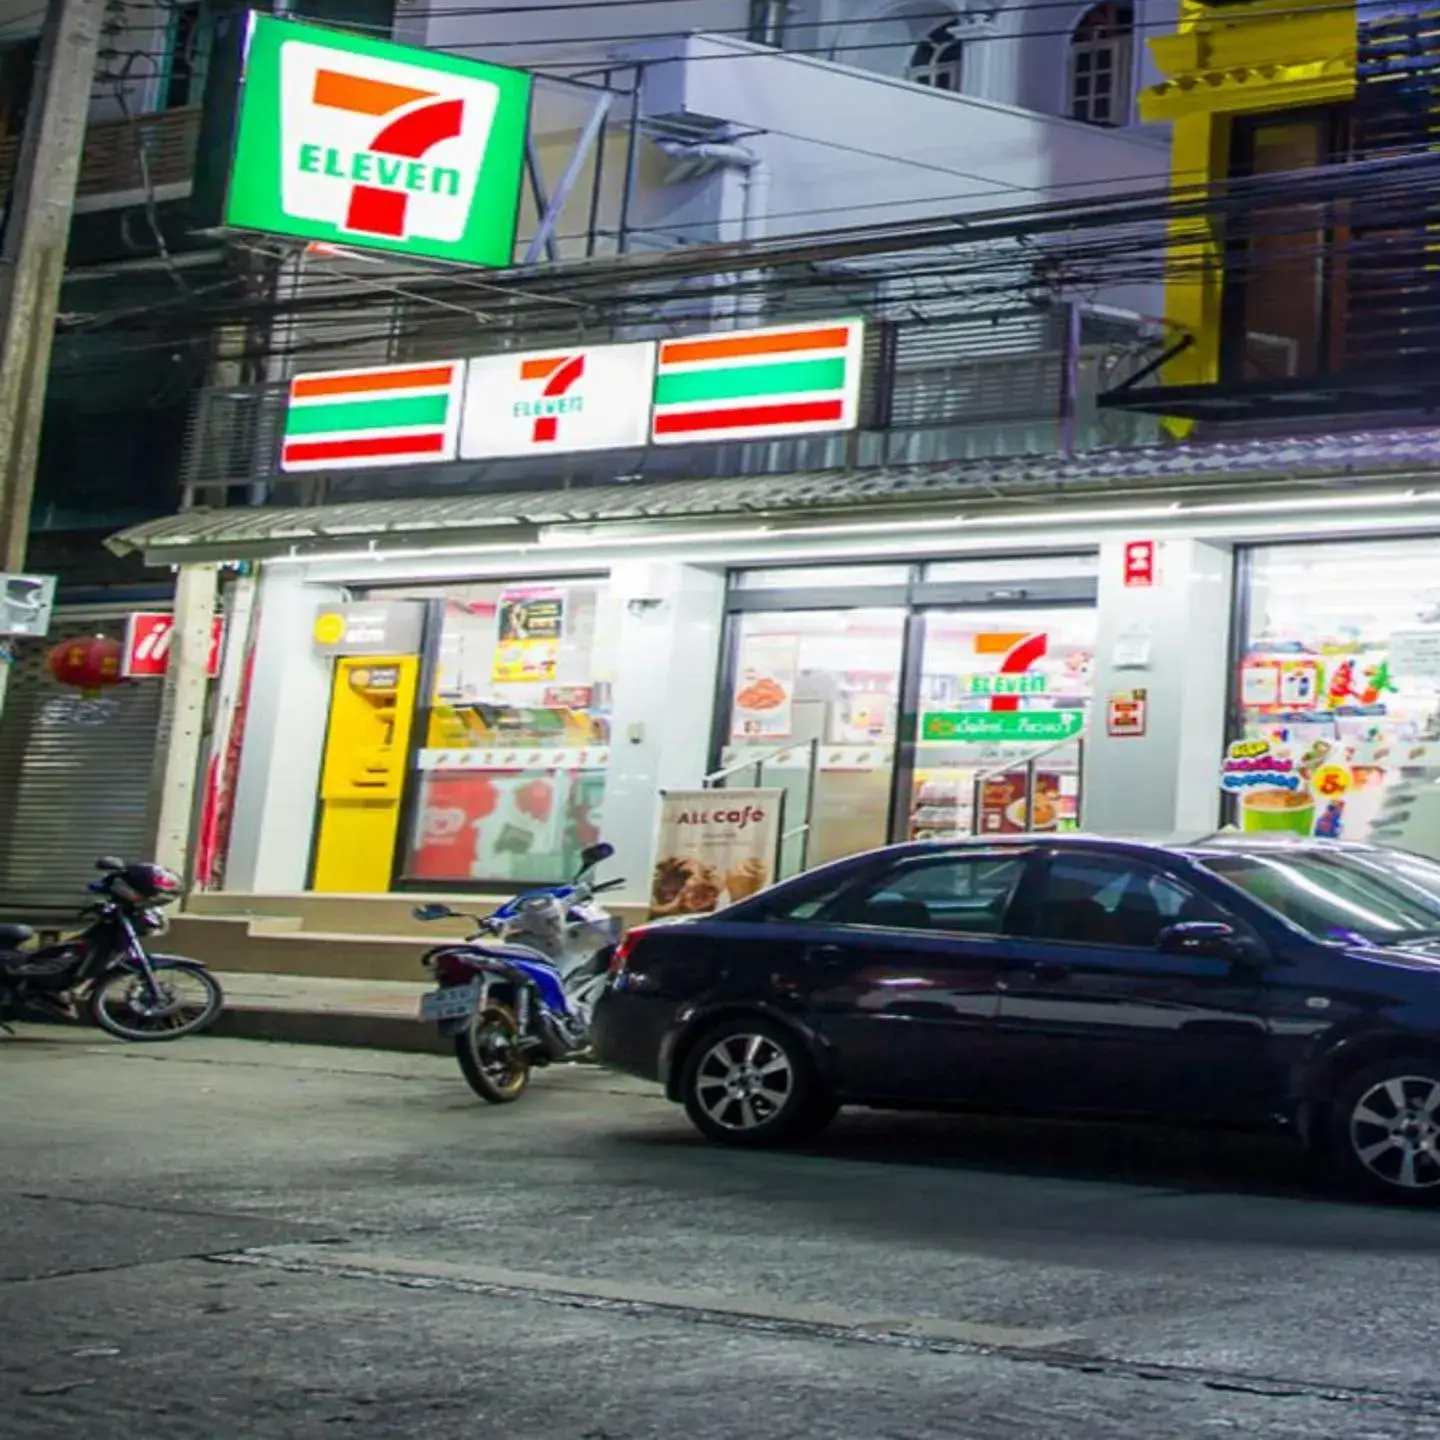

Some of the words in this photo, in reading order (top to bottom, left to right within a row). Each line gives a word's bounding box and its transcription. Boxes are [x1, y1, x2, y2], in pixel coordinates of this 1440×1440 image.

[312, 68, 464, 237] 7
[520, 354, 585, 442] 7
[974, 632, 1047, 712] 7
